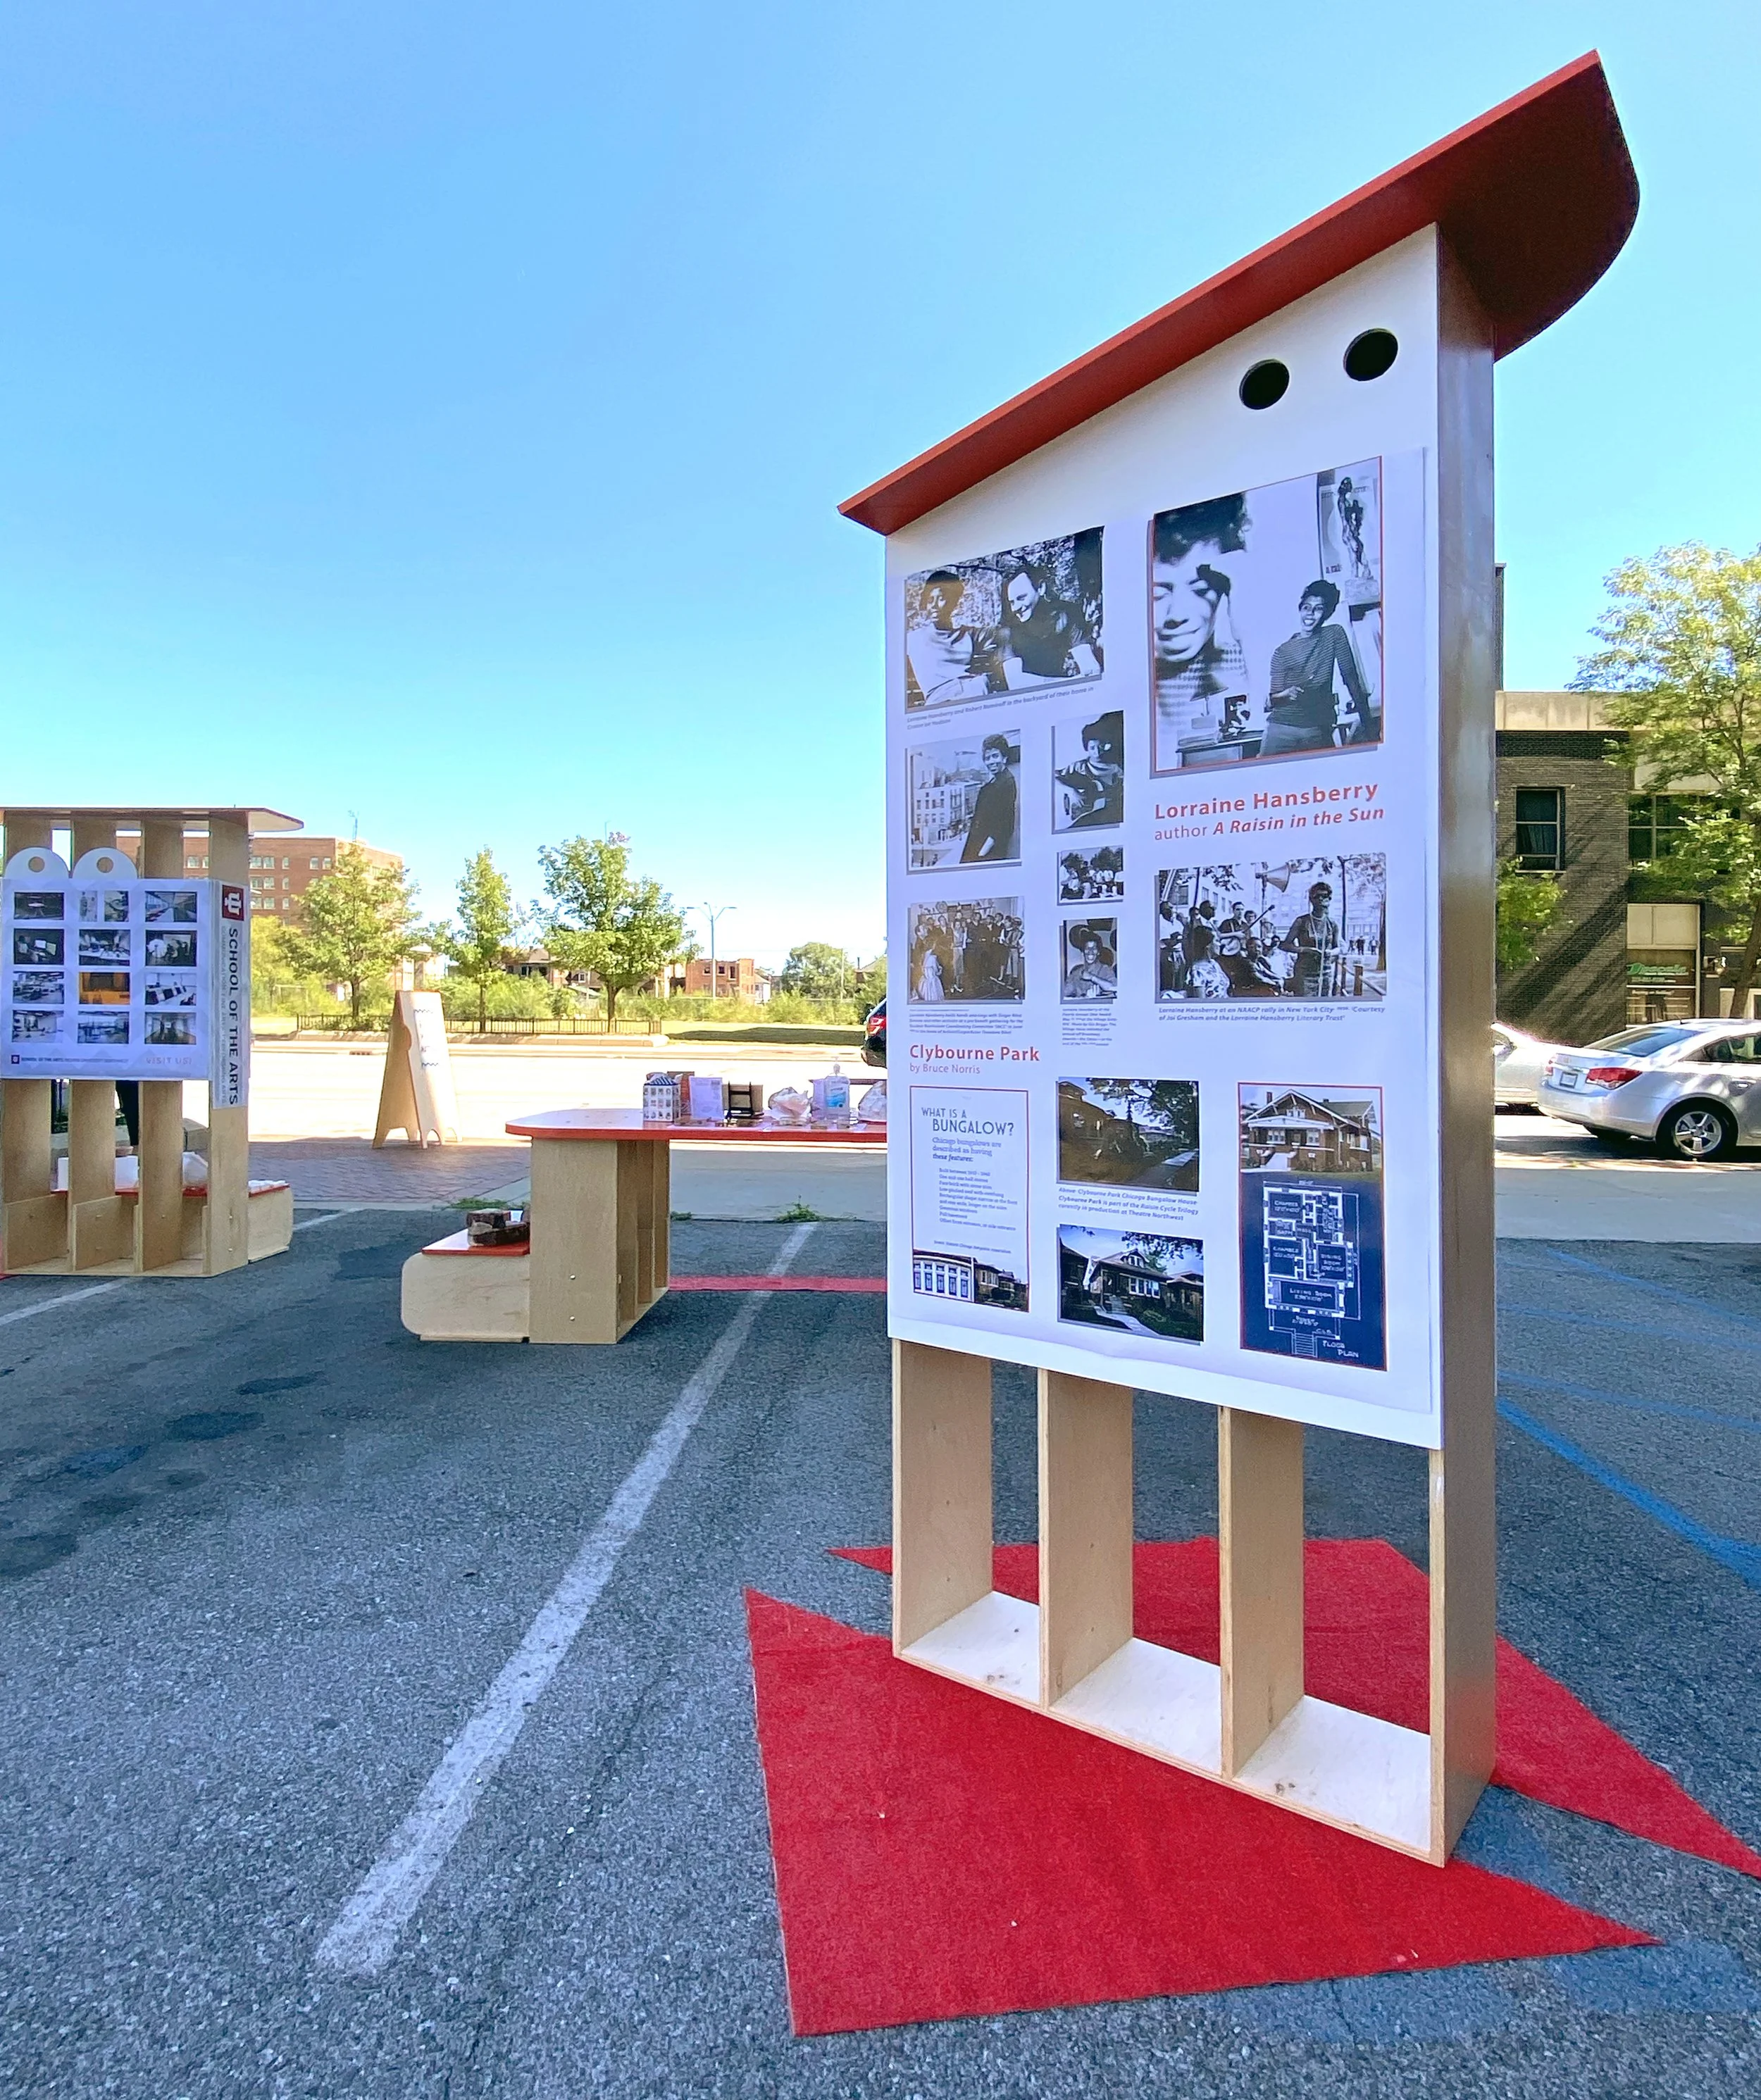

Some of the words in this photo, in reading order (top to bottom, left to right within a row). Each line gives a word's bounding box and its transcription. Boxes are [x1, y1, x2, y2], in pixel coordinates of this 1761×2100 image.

[1023, 694, 1049, 703] backyard
[1155, 797, 1245, 820] Lorraine
[1253, 784, 1378, 810] Hansberry
[1155, 825, 1207, 840] author
[1212, 822, 1224, 835] A
[1229, 816, 1283, 833] Raisin
[1290, 813, 1306, 828] in
[1313, 810, 1343, 826] the
[1348, 807, 1384, 822] Sun
[229, 927, 239, 996] SCHOOL
[229, 1001, 238, 1021] OF
[229, 1025, 238, 1056] THE
[910, 1044, 994, 1062] Clybourne
[1000, 1046, 1040, 1061] Park
[910, 1063, 920, 1073] by
[923, 1063, 949, 1073] Bruce
[952, 1064, 981, 1074] Norris
[229, 1062, 238, 1105] ARTS
[921, 1107, 946, 1118] WHAT
[950, 1109, 957, 1118] IS
[962, 1109, 967, 1118] A
[933, 1118, 1014, 1136] BUNGALOW?
[1178, 1207, 1199, 1215] Trilogy
[1338, 1349, 1359, 1358] PLAN
